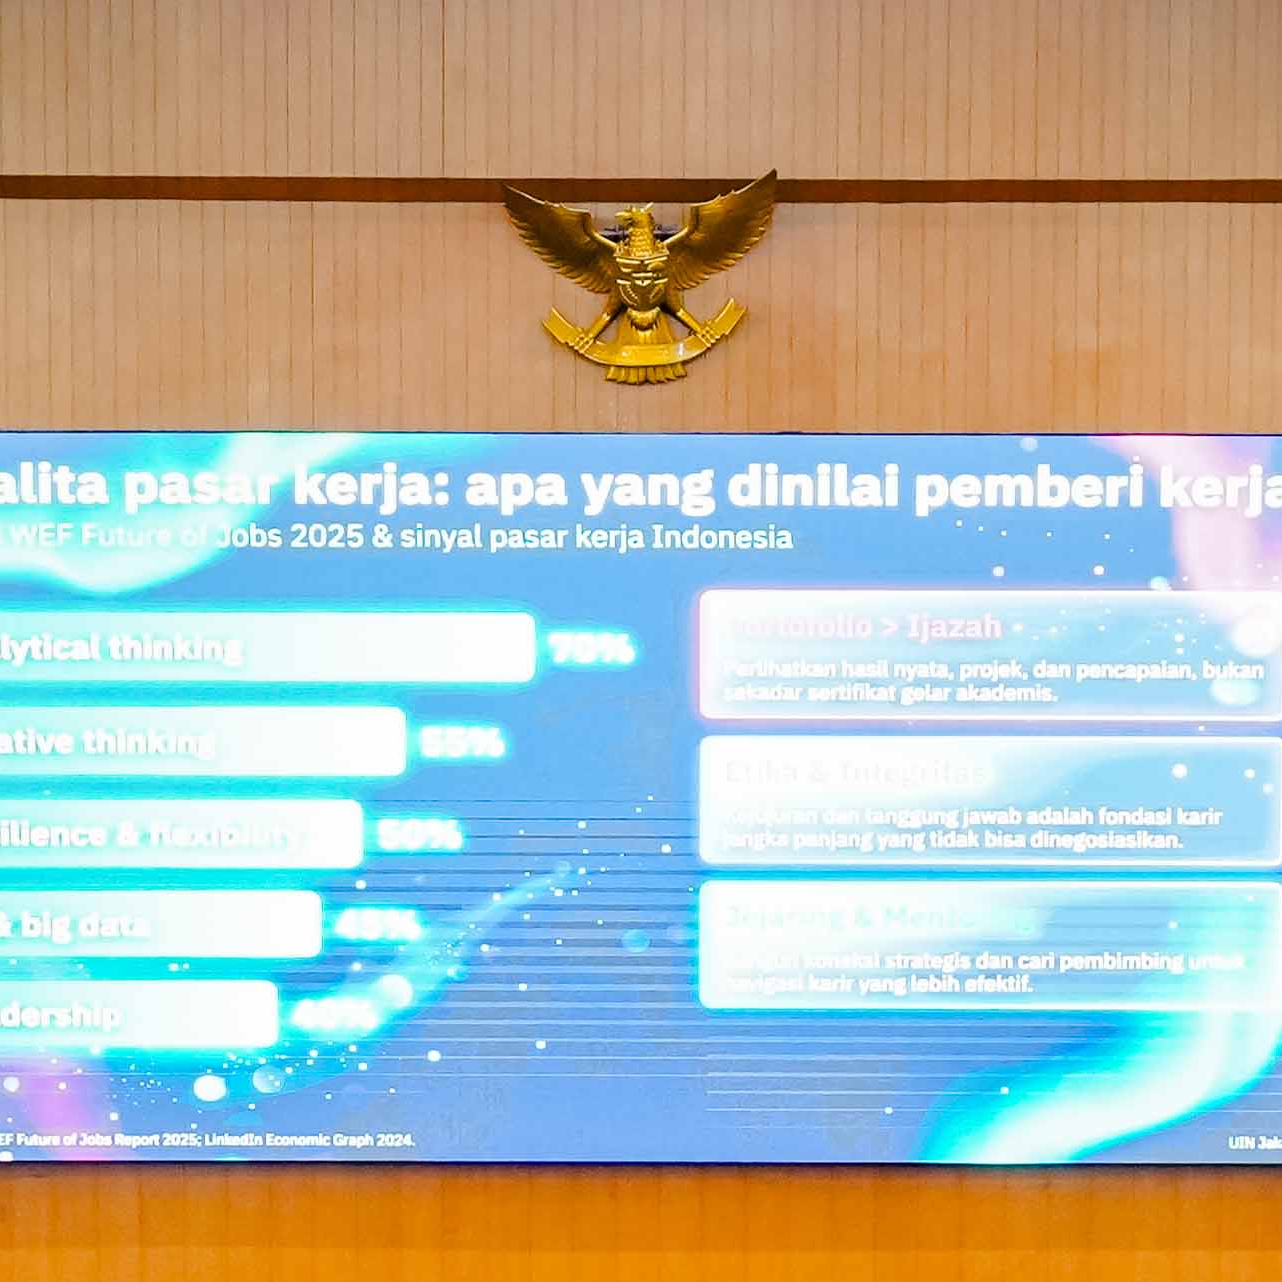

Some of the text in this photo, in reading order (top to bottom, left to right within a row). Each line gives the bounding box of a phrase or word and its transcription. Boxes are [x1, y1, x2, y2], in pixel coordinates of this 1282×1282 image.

[126, 470, 275, 514] pasar
[294, 461, 450, 514] kerja:
[465, 470, 567, 514] apa
[583, 470, 714, 516] yang
[728, 463, 898, 508] dinilai
[915, 464, 1143, 516] pemberi
[9, 523, 72, 546] WEF
[80, 523, 171, 547] Future
[217, 523, 281, 548] Jobs
[291, 523, 363, 548] 2025
[372, 524, 394, 548] &
[401, 523, 481, 555] sinyal
[490, 529, 567, 555] pasar
[575, 523, 643, 554] kerja
[651, 524, 793, 550] Indonesia
[907, 611, 1003, 643] Ijazah
[109, 632, 243, 667] thinking
[841, 659, 889, 679] hasil
[894, 660, 955, 682] nyata,
[959, 660, 1029, 682] projek,
[1033, 660, 1070, 679] dan
[1076, 661, 1198, 683] pencapaian,
[1203, 661, 1265, 680] bukan
[808, 684, 896, 702] sertifikat
[900, 684, 951, 706] gelar
[957, 684, 1059, 703] akademis.
[83, 726, 216, 760] thinking
[868, 807, 960, 829] tanggung
[962, 806, 1023, 829] jawab
[1027, 807, 1094, 826] adalah
[1099, 807, 1172, 826] fondasi
[1177, 807, 1224, 826] karir
[117, 821, 140, 850] &
[793, 831, 874, 852] panjang
[879, 833, 927, 852] yang
[930, 831, 980, 849] tidak
[984, 830, 1027, 849] bisa
[1031, 830, 1184, 853] dinegosiasikan.
[21, 910, 72, 945] big
[78, 911, 151, 939] data
[885, 952, 972, 974] strategis
[976, 952, 1013, 970] dan
[1018, 952, 1056, 970] cari
[1059, 953, 1185, 975] pembimbing
[809, 975, 852, 993] karir
[857, 978, 907, 997] yang
[910, 975, 960, 993] lebih
[964, 975, 1034, 993] efektif.
[16, 1133, 60, 1147] Future
[63, 1133, 78, 1147] of
[79, 1133, 113, 1147] Jobs
[115, 1133, 160, 1149] Report
[162, 1133, 202, 1147] 2025;
[204, 1133, 264, 1147] LinkedIn
[266, 1133, 330, 1147] Economic
[333, 1134, 374, 1149] Graph
[376, 1134, 416, 1147] 2024.
[1228, 1136, 1256, 1149] UIN
